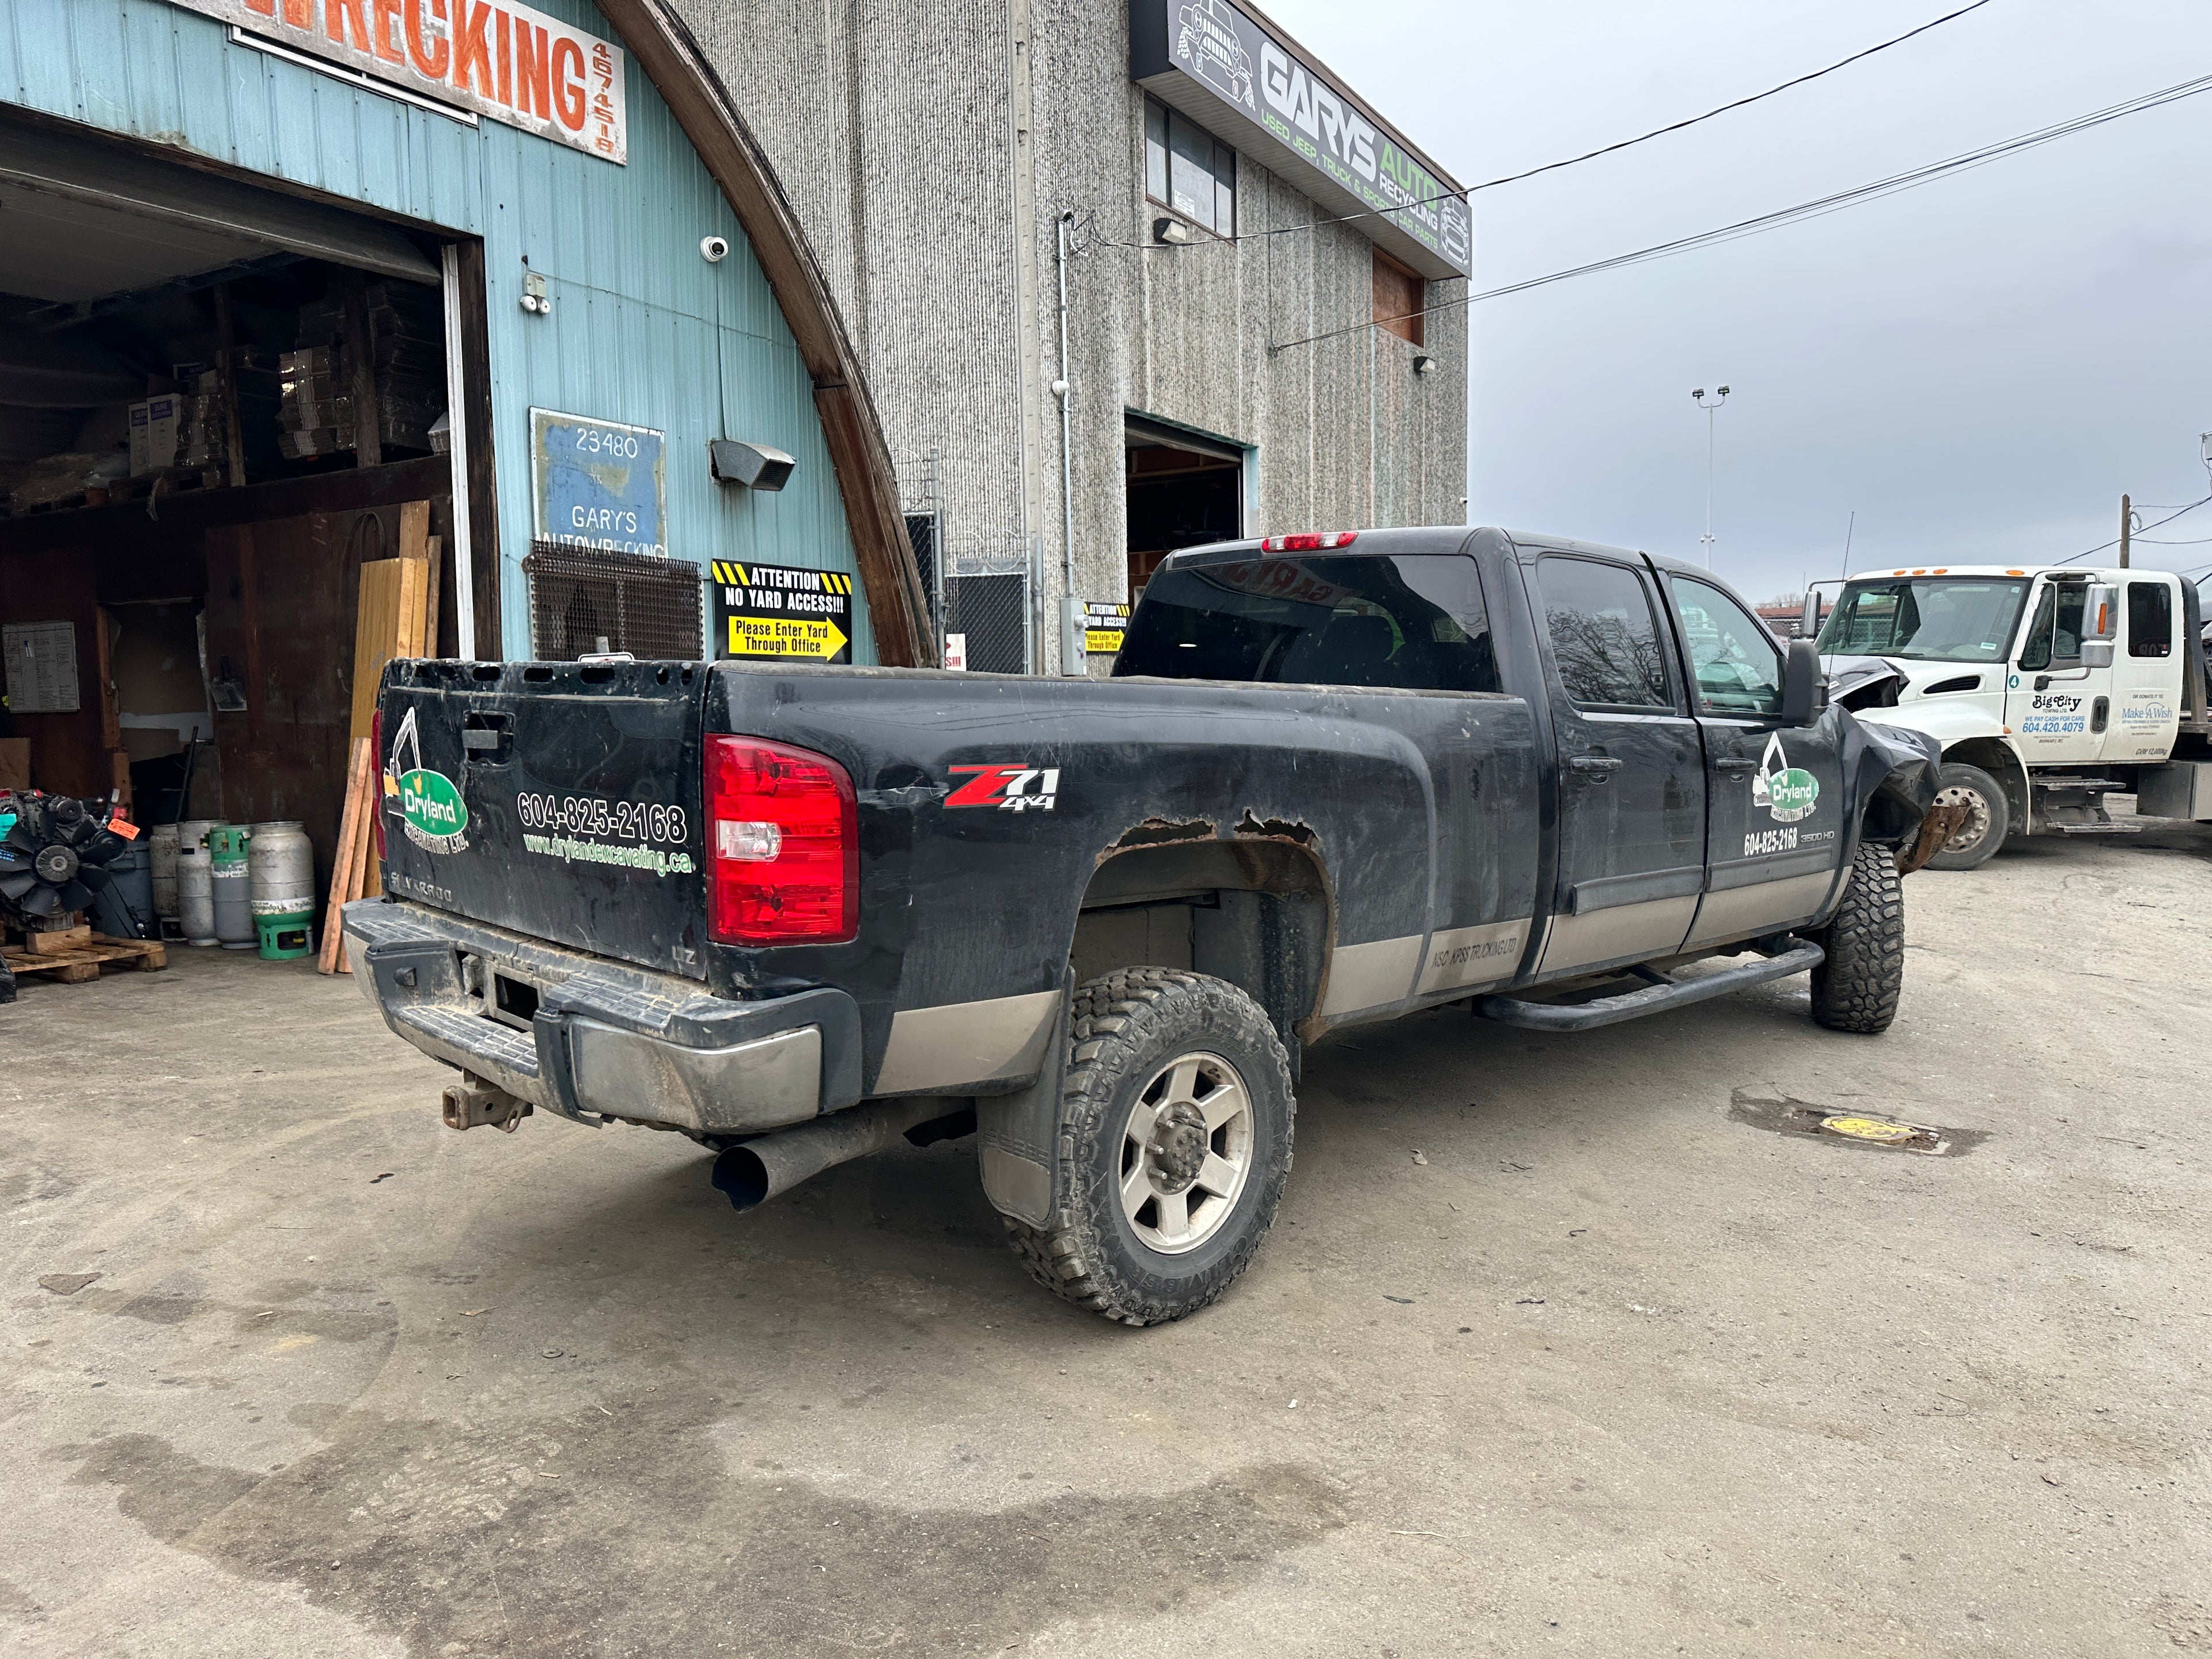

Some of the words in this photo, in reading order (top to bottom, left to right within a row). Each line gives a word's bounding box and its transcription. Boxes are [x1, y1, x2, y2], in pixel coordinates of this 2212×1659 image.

[243, 0, 586, 132] RECKING
[1260, 41, 1376, 182] GARYS
[1380, 142, 1437, 211] AUTO
[1261, 108, 1290, 141] USED
[1293, 135, 1319, 166] JEEP,
[1321, 153, 1352, 187] TRUCK
[1354, 179, 1361, 193] &
[1363, 185, 1395, 218] SPORTS
[1398, 211, 1414, 232] CAR
[1415, 224, 1438, 250] PARTS
[1379, 172, 1438, 231] RECYCLING
[576, 427, 638, 459] 23480
[572, 505, 637, 533] GARY'S
[751, 567, 820, 591] ATTENTION
[725, 587, 744, 607] NO
[748, 589, 782, 609] YARD
[787, 592, 844, 613] ACCESS!!!
[1089, 604, 1117, 615] ATTENTION
[736, 620, 771, 635] Please
[775, 622, 802, 637] Enter
[806, 624, 828, 638] Yard
[1088, 616, 1102, 626] YARD
[745, 637, 787, 653] Through
[791, 638, 821, 653] Office
[1088, 641, 1104, 650] Through
[2010, 676, 2017, 687] 4
[2032, 695, 2053, 709] Big
[2053, 695, 2082, 711] City
[2022, 722, 2084, 733] 604.420.4079
[942, 763, 1061, 809] Z71
[1773, 782, 1812, 802] Dryland
[404, 787, 457, 824] Dryland
[518, 792, 687, 844] 604-825-2168
[449, 831, 469, 854] LTD.
[1744, 827, 1798, 856] 604-825-2168
[1800, 832, 1822, 843] 3500
[1823, 831, 1835, 840] HD
[523, 833, 692, 877] www.drylandexcavating.ca
[1469, 940, 1504, 961] TRUCKING
[1503, 937, 1517, 954] LTD
